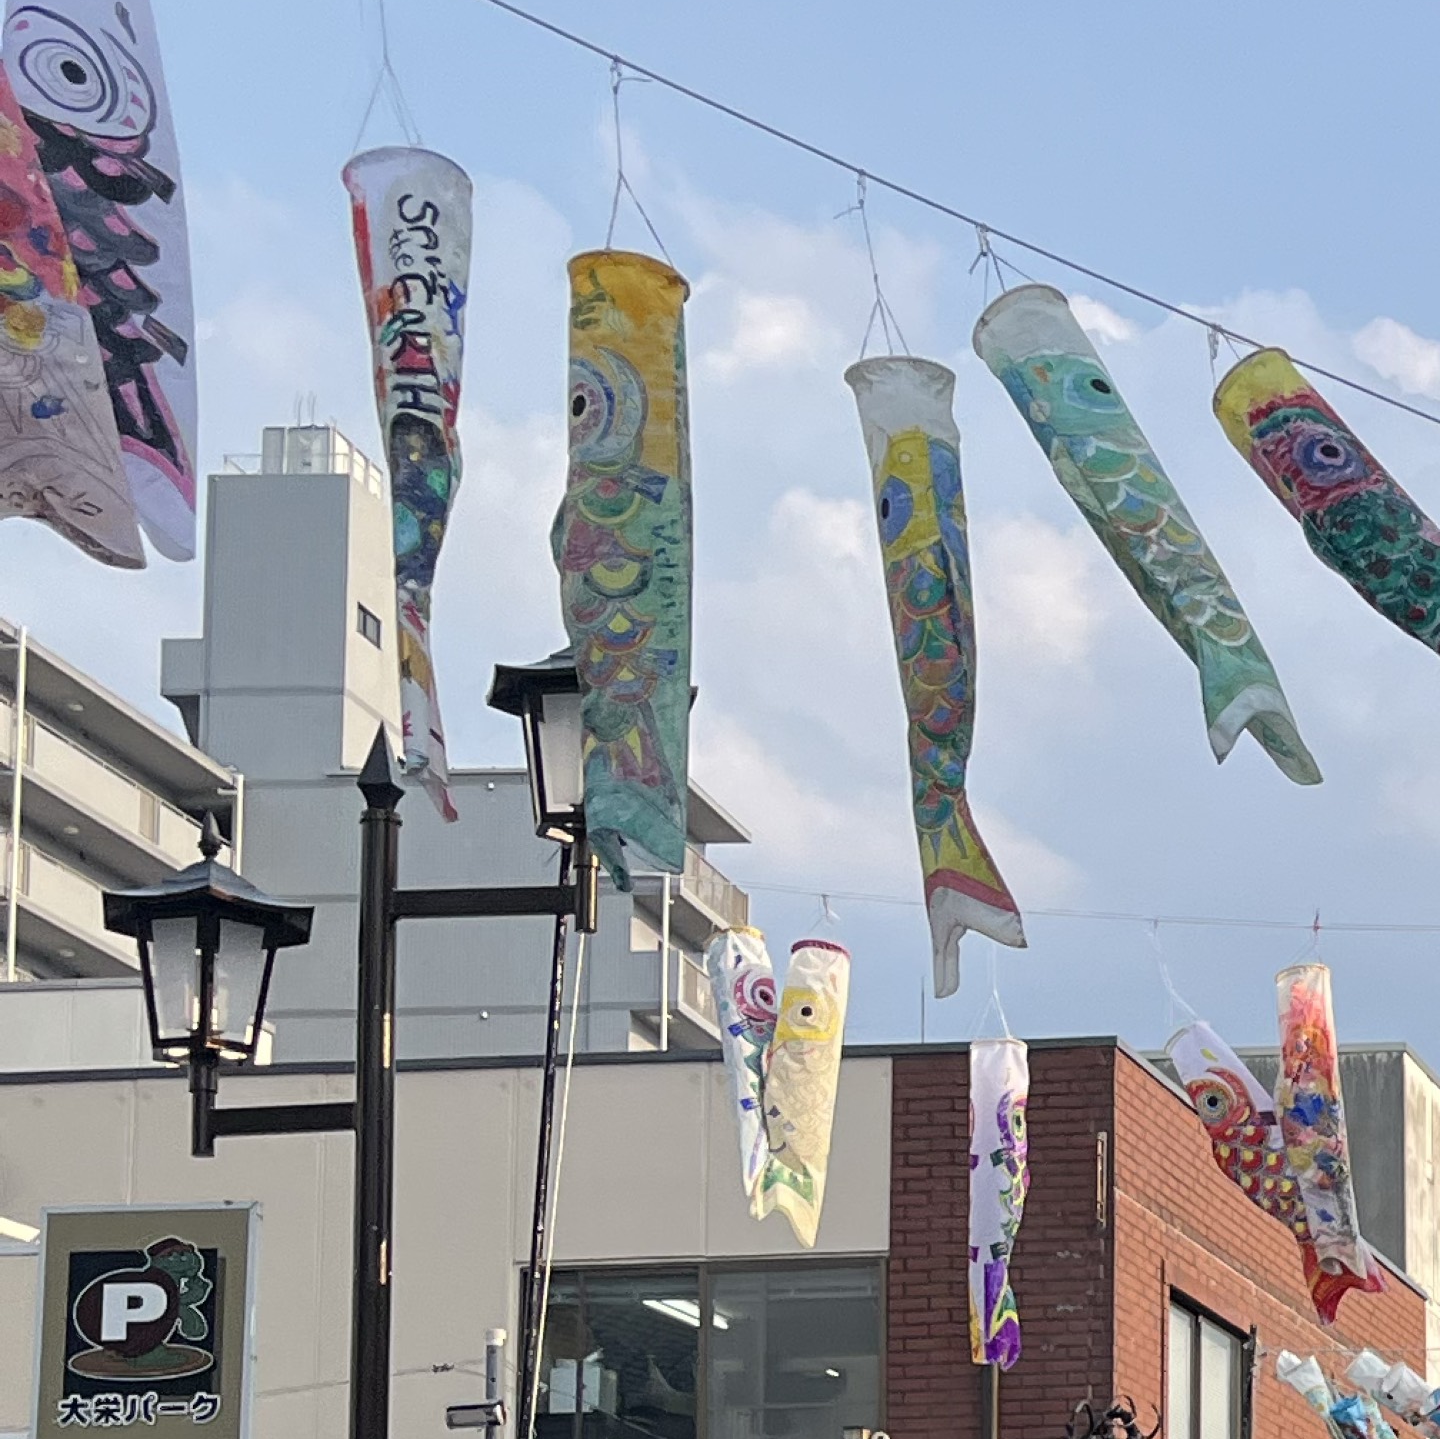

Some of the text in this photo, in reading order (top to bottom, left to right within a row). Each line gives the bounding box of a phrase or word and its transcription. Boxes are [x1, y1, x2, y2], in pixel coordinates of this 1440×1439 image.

[379, 272, 443, 416] EARTH
[101, 1282, 167, 1341] P
[58, 1393, 220, 1426] 大栄パーク
